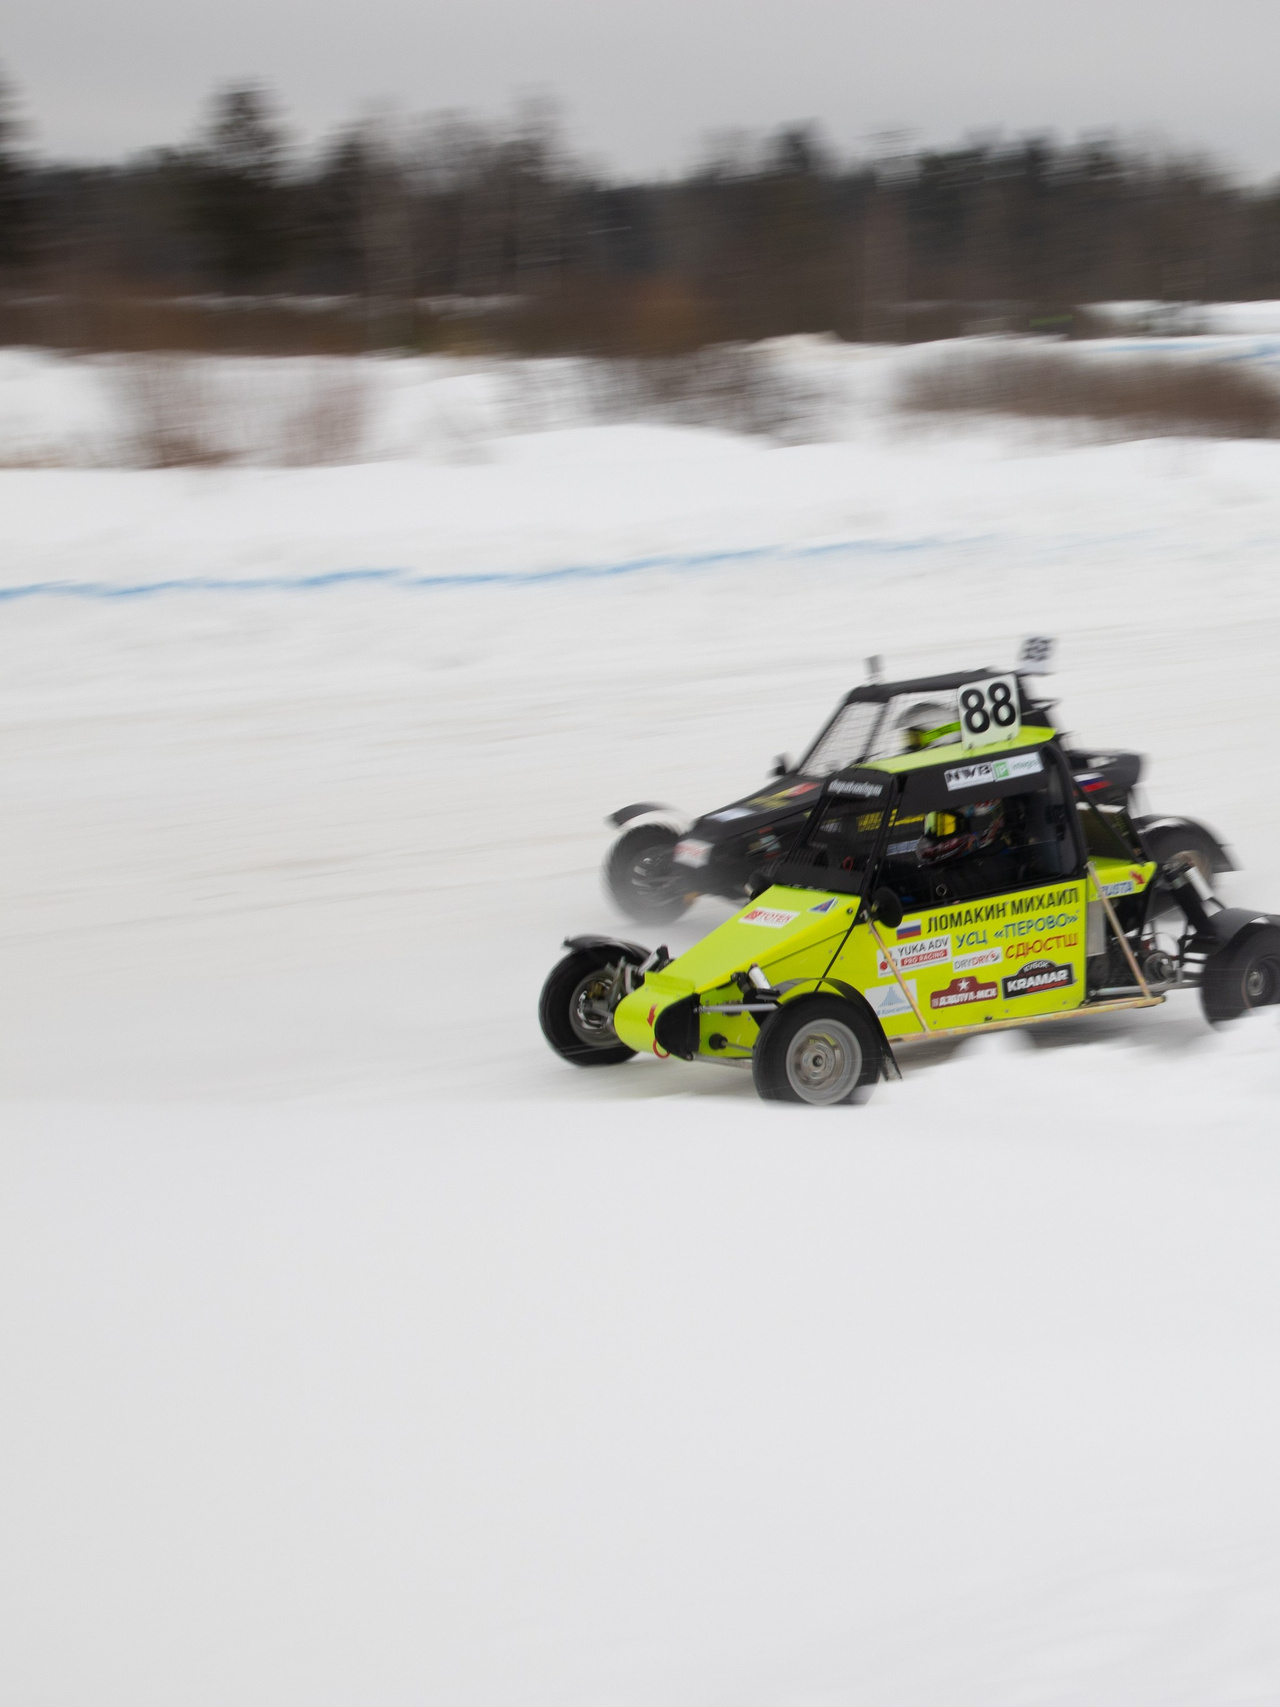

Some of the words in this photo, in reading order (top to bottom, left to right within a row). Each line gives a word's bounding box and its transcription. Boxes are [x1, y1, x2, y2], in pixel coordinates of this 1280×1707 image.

[961, 682, 1016, 734] 88
[927, 905, 1006, 933] ЛОМАКИН
[1011, 887, 1079, 915] МИХАИЛ
[956, 930, 988, 948] УСЦ
[994, 913, 1079, 939] «ПЕРОВО»
[897, 943, 926, 957] YUKA
[928, 937, 949, 951] ADV
[903, 955, 918, 965] PRO
[919, 950, 946, 961] RACING
[1005, 933, 1079, 960] СДЮСТШ
[1023, 960, 1050, 972] КУБОК
[1006, 969, 1070, 993] KRAMAR
